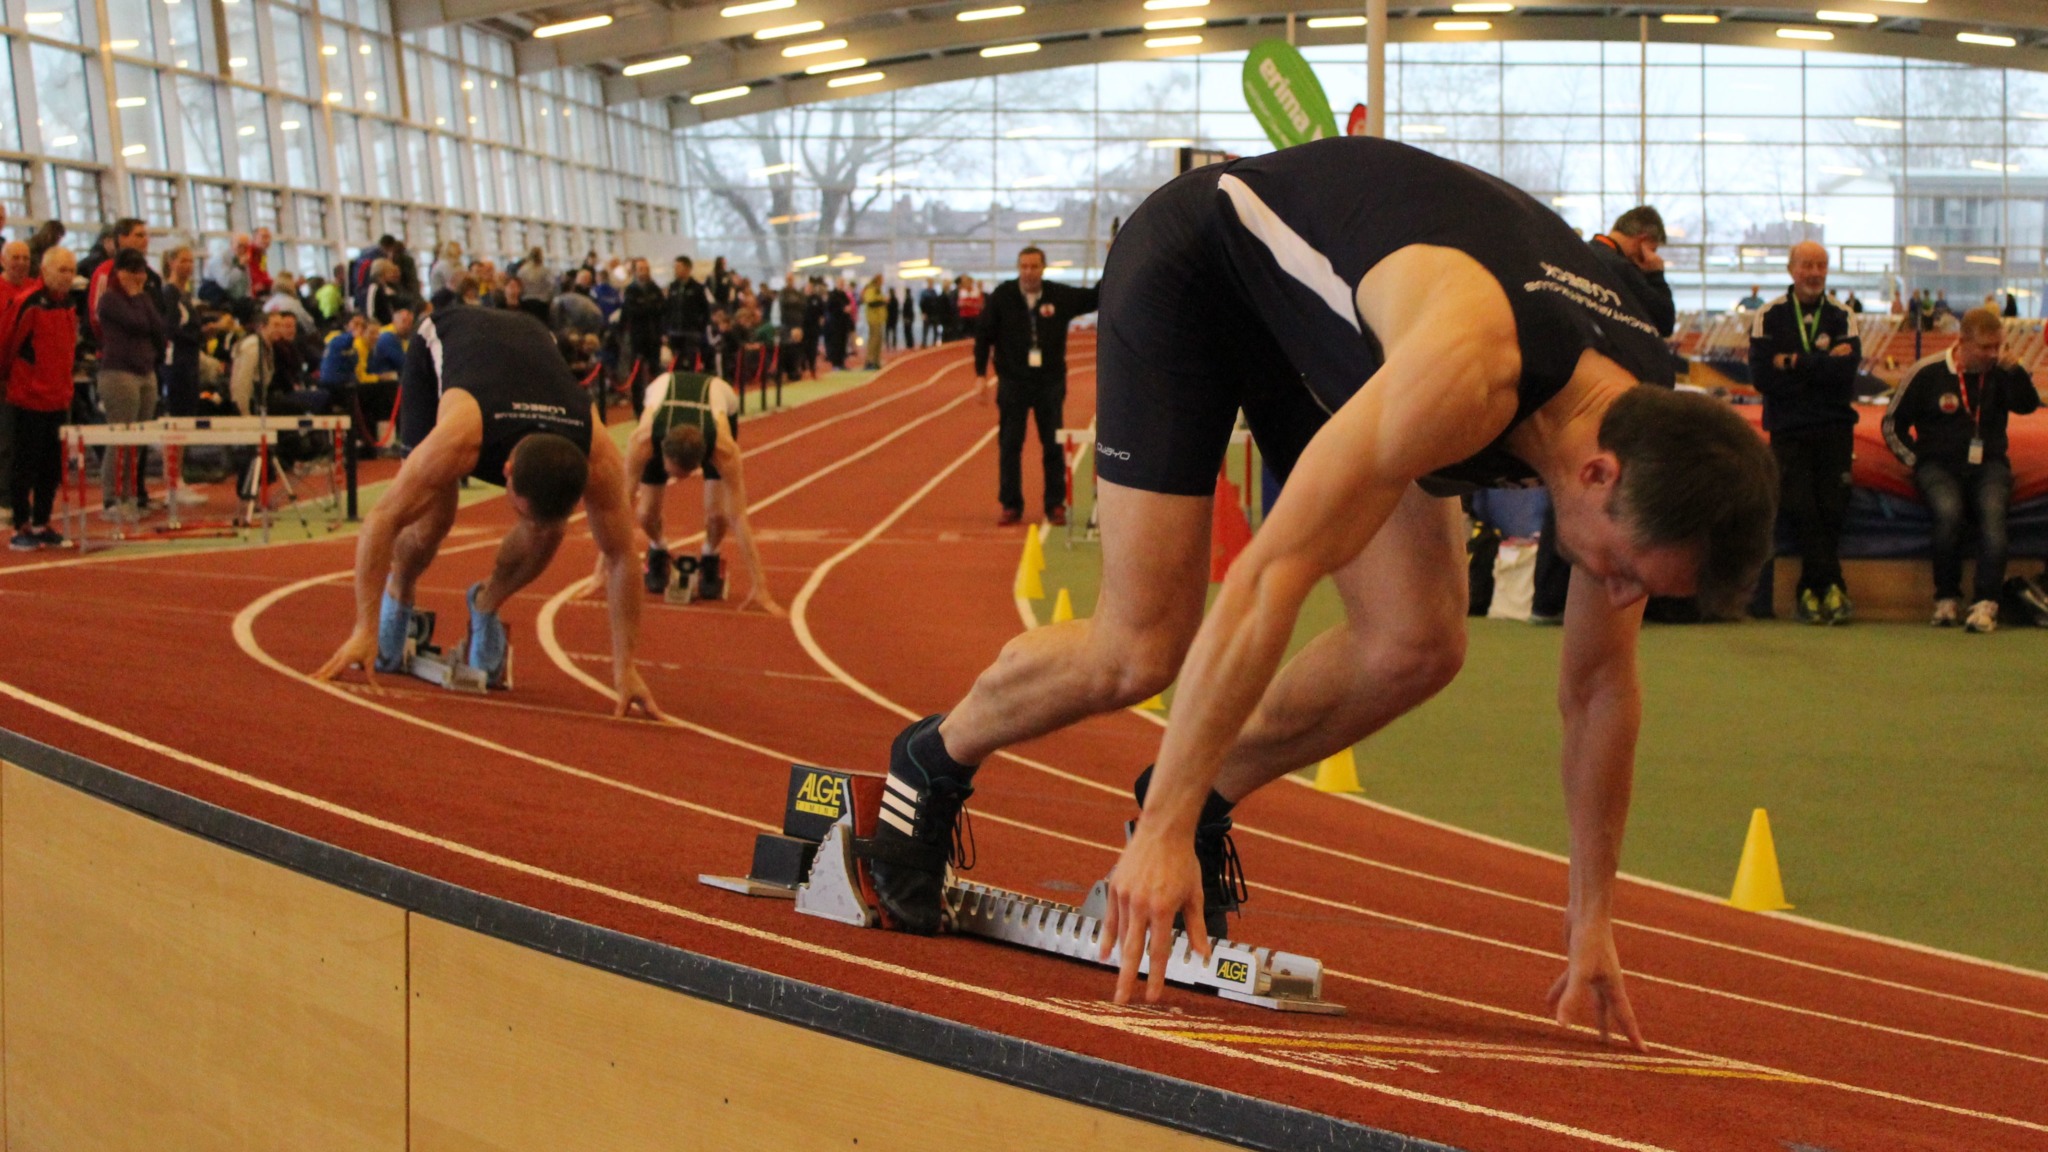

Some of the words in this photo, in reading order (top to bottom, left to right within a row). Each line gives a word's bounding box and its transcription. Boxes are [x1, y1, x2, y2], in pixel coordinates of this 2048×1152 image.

[1259, 57, 1311, 134] erima
[797, 772, 844, 806] ALGE
[797, 801, 838, 817] TIMING
[1217, 960, 1248, 982] ALGE
